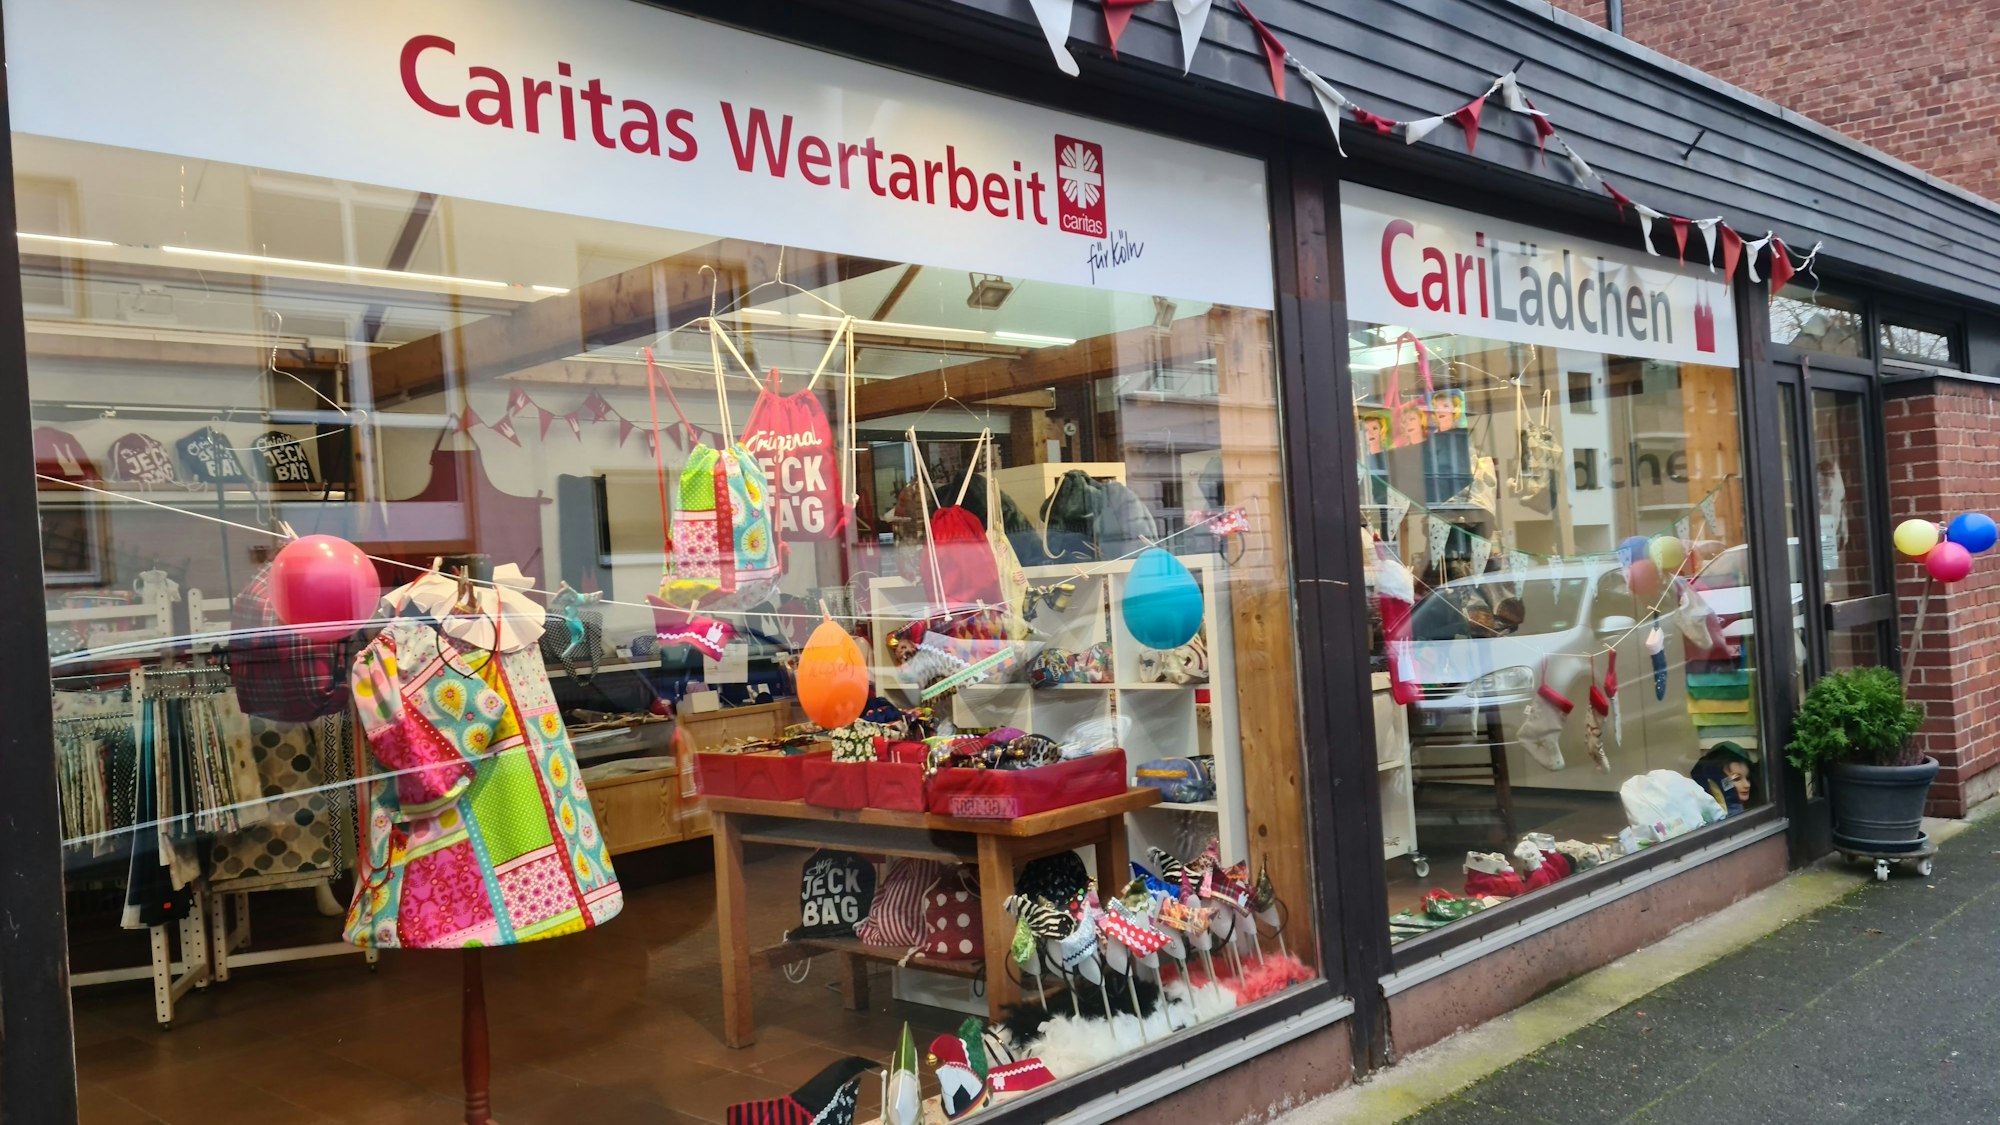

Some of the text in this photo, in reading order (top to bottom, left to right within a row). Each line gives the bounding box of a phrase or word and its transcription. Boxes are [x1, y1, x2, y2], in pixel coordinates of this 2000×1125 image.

[400, 34, 1048, 226] Caritas Wertarbeit
[1062, 213, 1103, 234] caritas
[1086, 241, 1109, 285] für
[1381, 219, 1674, 344] CariLädchen
[801, 867, 862, 900] JECK
